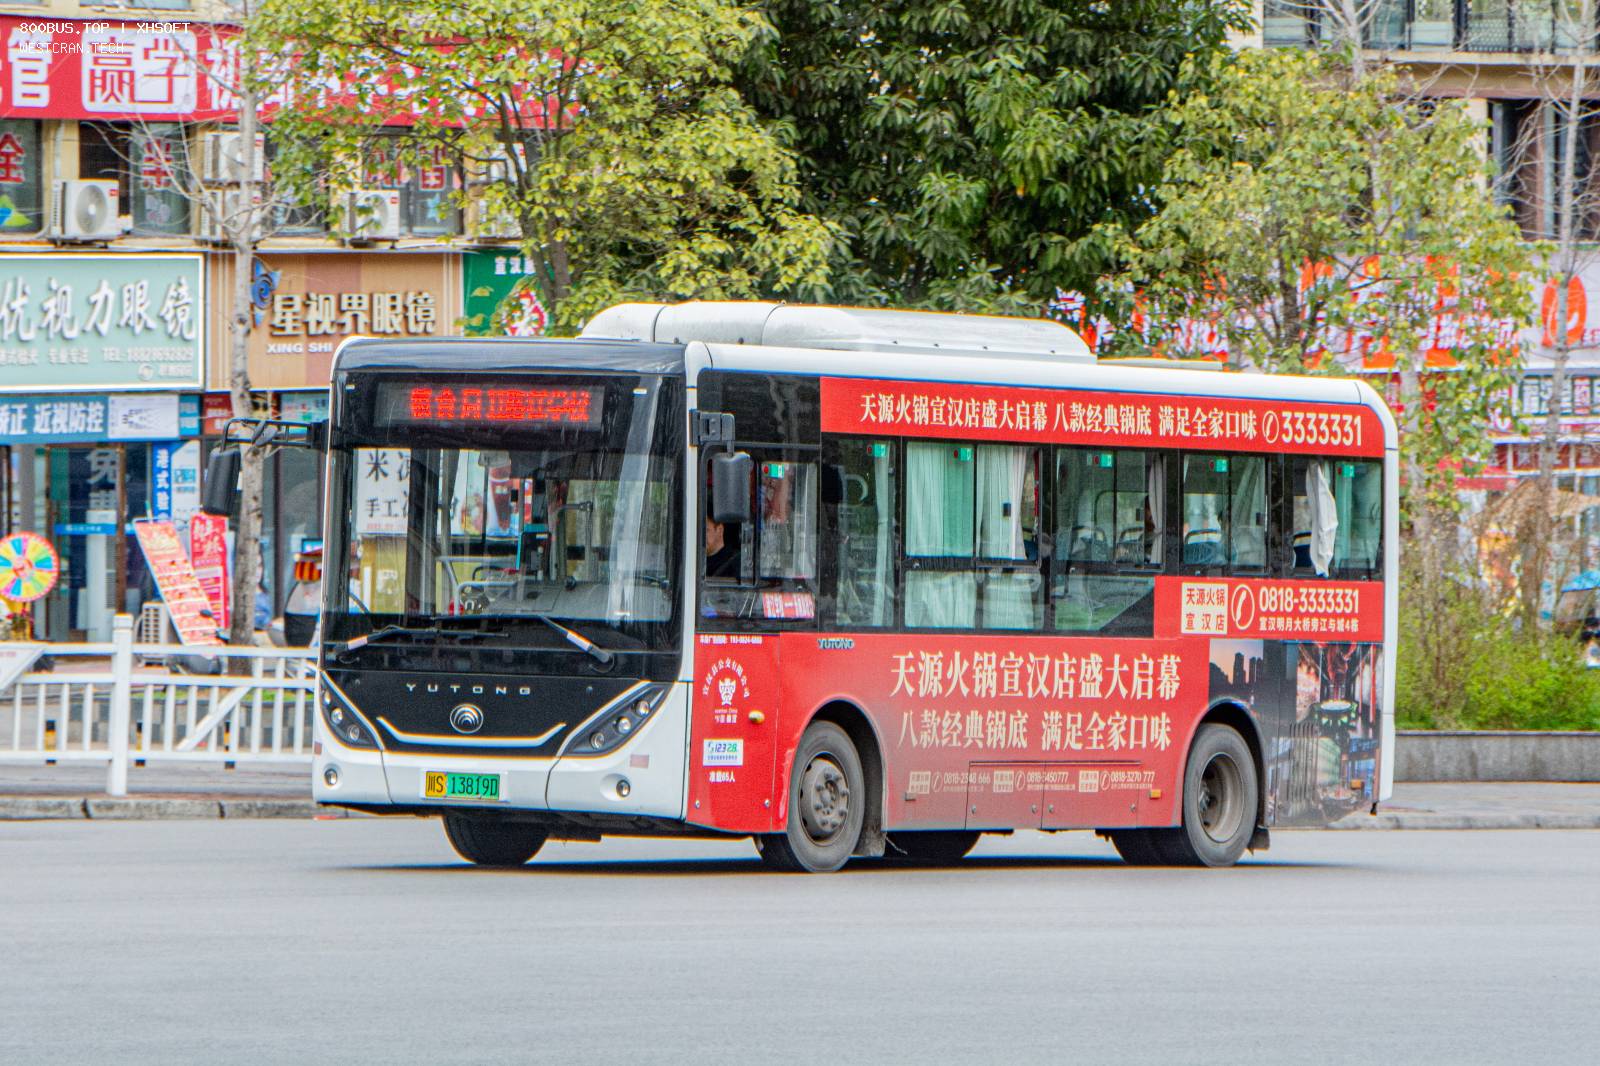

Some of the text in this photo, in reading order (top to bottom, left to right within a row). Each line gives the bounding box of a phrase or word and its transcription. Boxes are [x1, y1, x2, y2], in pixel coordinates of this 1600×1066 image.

[0, 275, 197, 341] 优视力眼镜
[270, 291, 436, 336] 星视界眼镜
[266, 342, 333, 354] XING SHI
[33, 402, 104, 434] 近视防控
[859, 392, 1362, 446] 天源火锅宣汉店盛大启幕 八款经典锅底 满足全家口味 3333331
[365, 497, 409, 518] 手工
[1185, 587, 1225, 607] 天源火锅
[1258, 585, 1360, 614] 0818-3333331
[1185, 612, 1225, 632] 宣汉店
[406, 683, 531, 695] YUTONG
[889, 650, 1182, 701] 天源火锅宣汉店盛大启幕
[898, 709, 1172, 751] 八款经典锅底 满足全家口味
[427, 775, 499, 796] 川S 13819D
